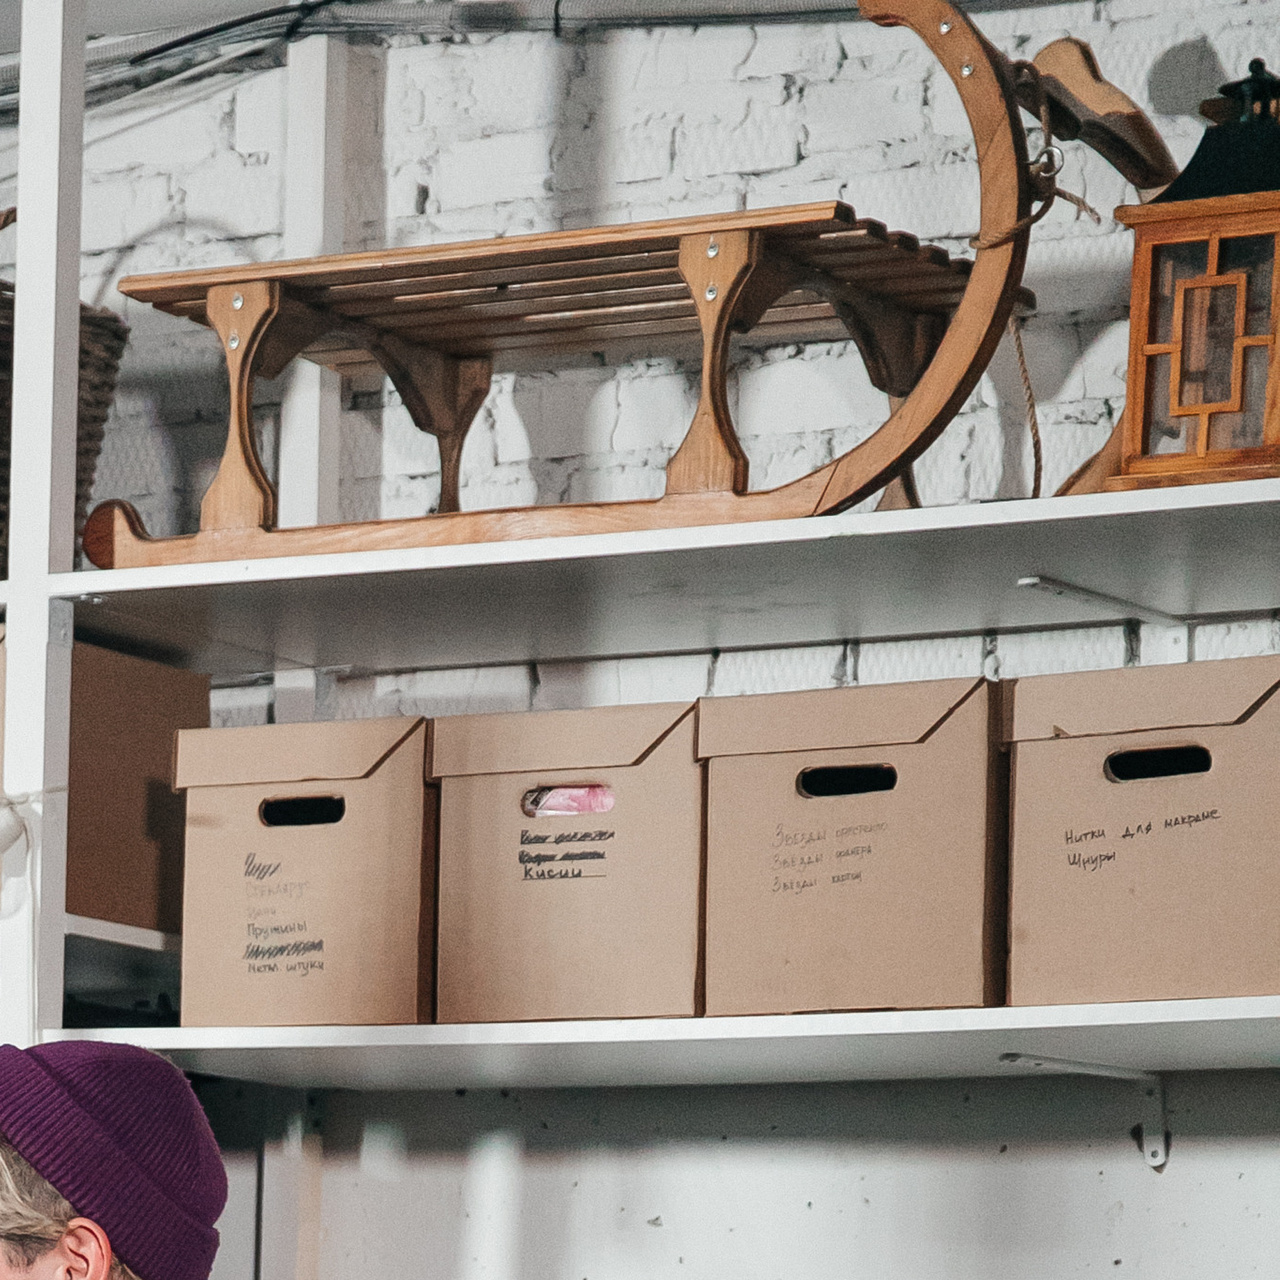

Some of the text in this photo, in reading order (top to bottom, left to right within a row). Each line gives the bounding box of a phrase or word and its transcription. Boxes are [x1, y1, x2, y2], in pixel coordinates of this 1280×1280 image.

[1065, 808, 1223, 845] Нитки для макраме
[1066, 851, 1117, 873] Шнуры
[247, 921, 308, 941] Пружины
